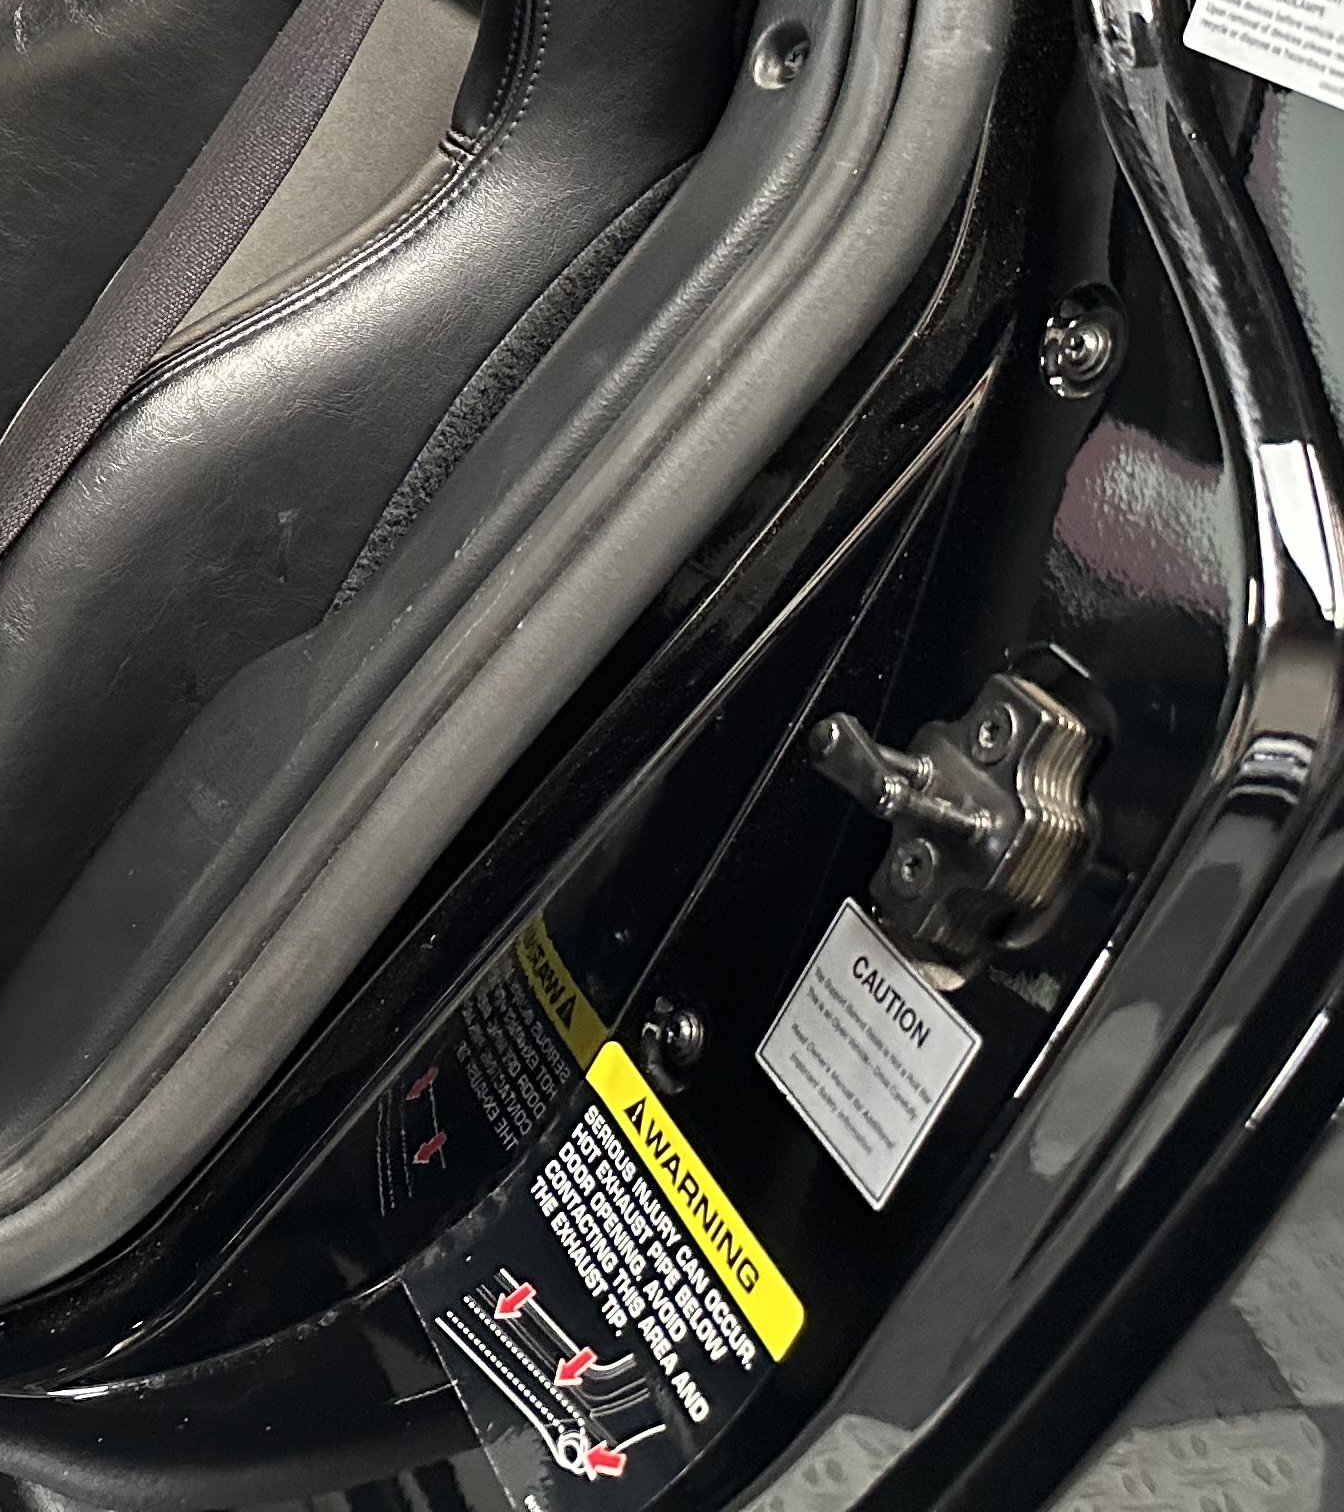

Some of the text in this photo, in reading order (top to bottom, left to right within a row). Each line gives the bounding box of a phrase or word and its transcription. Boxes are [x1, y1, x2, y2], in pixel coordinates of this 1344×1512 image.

[853, 956, 930, 1048] CAUTION
[531, 1176, 627, 1336] THE EXHAUST TIP.
[545, 1160, 709, 1422] CONTACTING THIS AREA AND
[559, 1142, 687, 1342] DOOR OPENING. AVOID
[572, 1123, 728, 1360] HOT EXHAUST PIPE BELOW
[584, 1105, 755, 1370] SERIOUS INJURY CAN OCCUR.
[646, 1120, 758, 1292] WARNING
